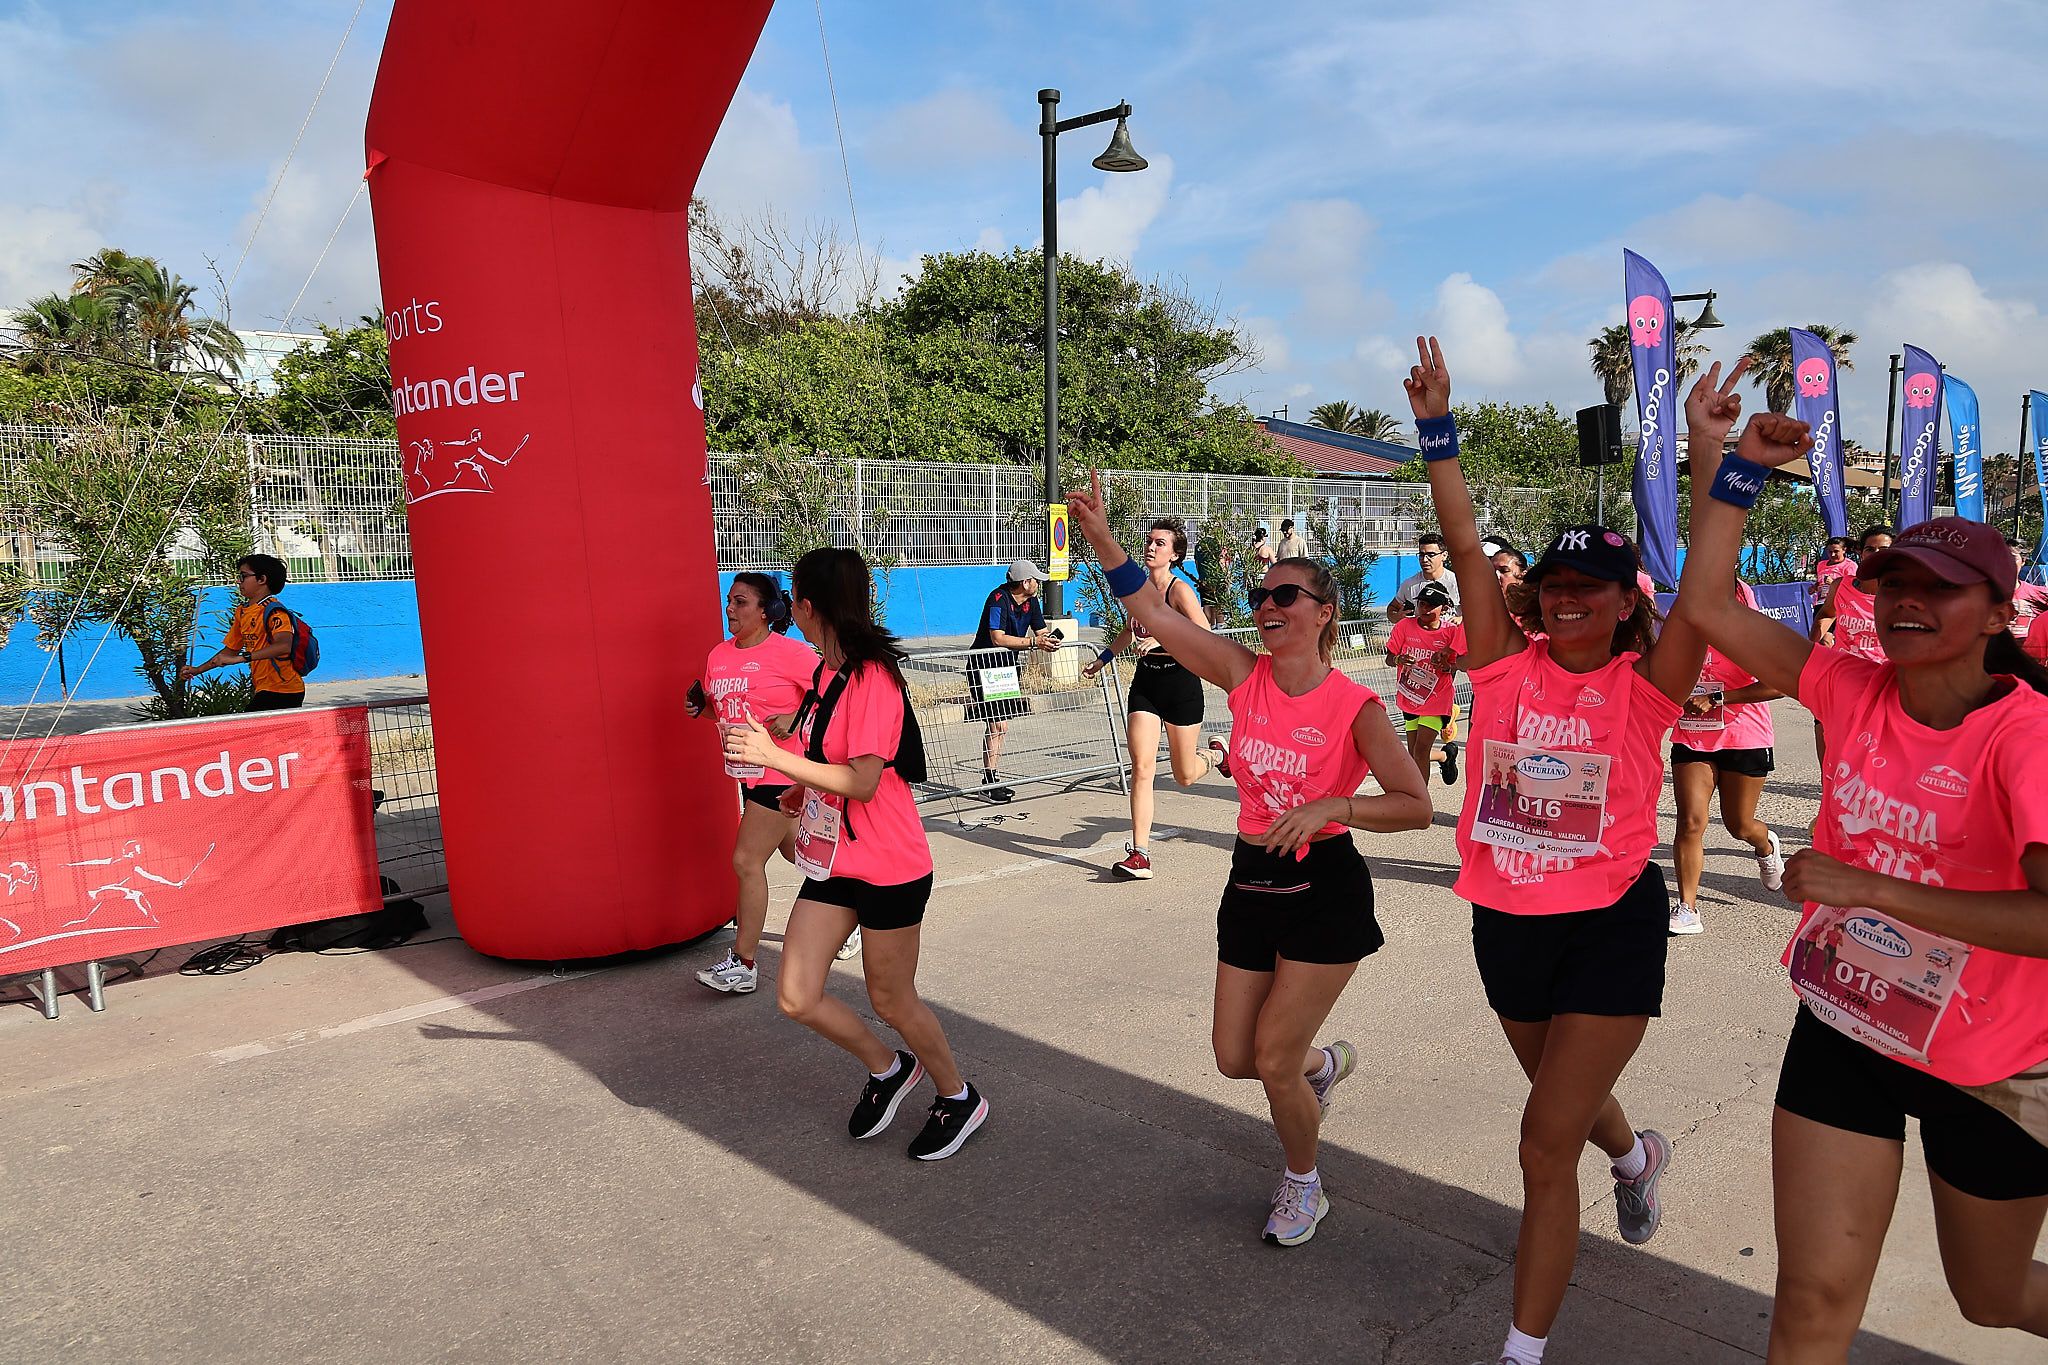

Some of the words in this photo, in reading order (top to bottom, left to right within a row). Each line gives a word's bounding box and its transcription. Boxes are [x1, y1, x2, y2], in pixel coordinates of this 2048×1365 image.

[1420, 435, 1450, 451] Marlene
[709, 677, 748, 694] ARRERA
[1493, 750, 1516, 761] SUMA
[1520, 761, 1567, 777] ASTURIANA
[1518, 795, 1562, 818] 016
[1488, 817, 1515, 829] CARRERA
[1515, 823, 1524, 831] DE
[1523, 825, 1531, 833] LA
[1532, 828, 1553, 837] MUJER
[1558, 832, 1586, 841] VALENCIA
[1527, 817, 1549, 829] 3285
[1486, 829, 1525, 845] OYSHO
[1546, 844, 1583, 854] Santander
[1849, 921, 1906, 955] ASTURIANA
[1835, 961, 1890, 1002] 016
[1800, 992, 1837, 1021] OYSHO
[1844, 990, 1868, 1009] 3284
[1800, 978, 1828, 998] CARRERA
[1829, 994, 1838, 1004] DE
[1839, 1000, 1848, 1010] LA
[1849, 1005, 1871, 1023] MUJER
[1876, 1020, 1909, 1043] VALENCIA
